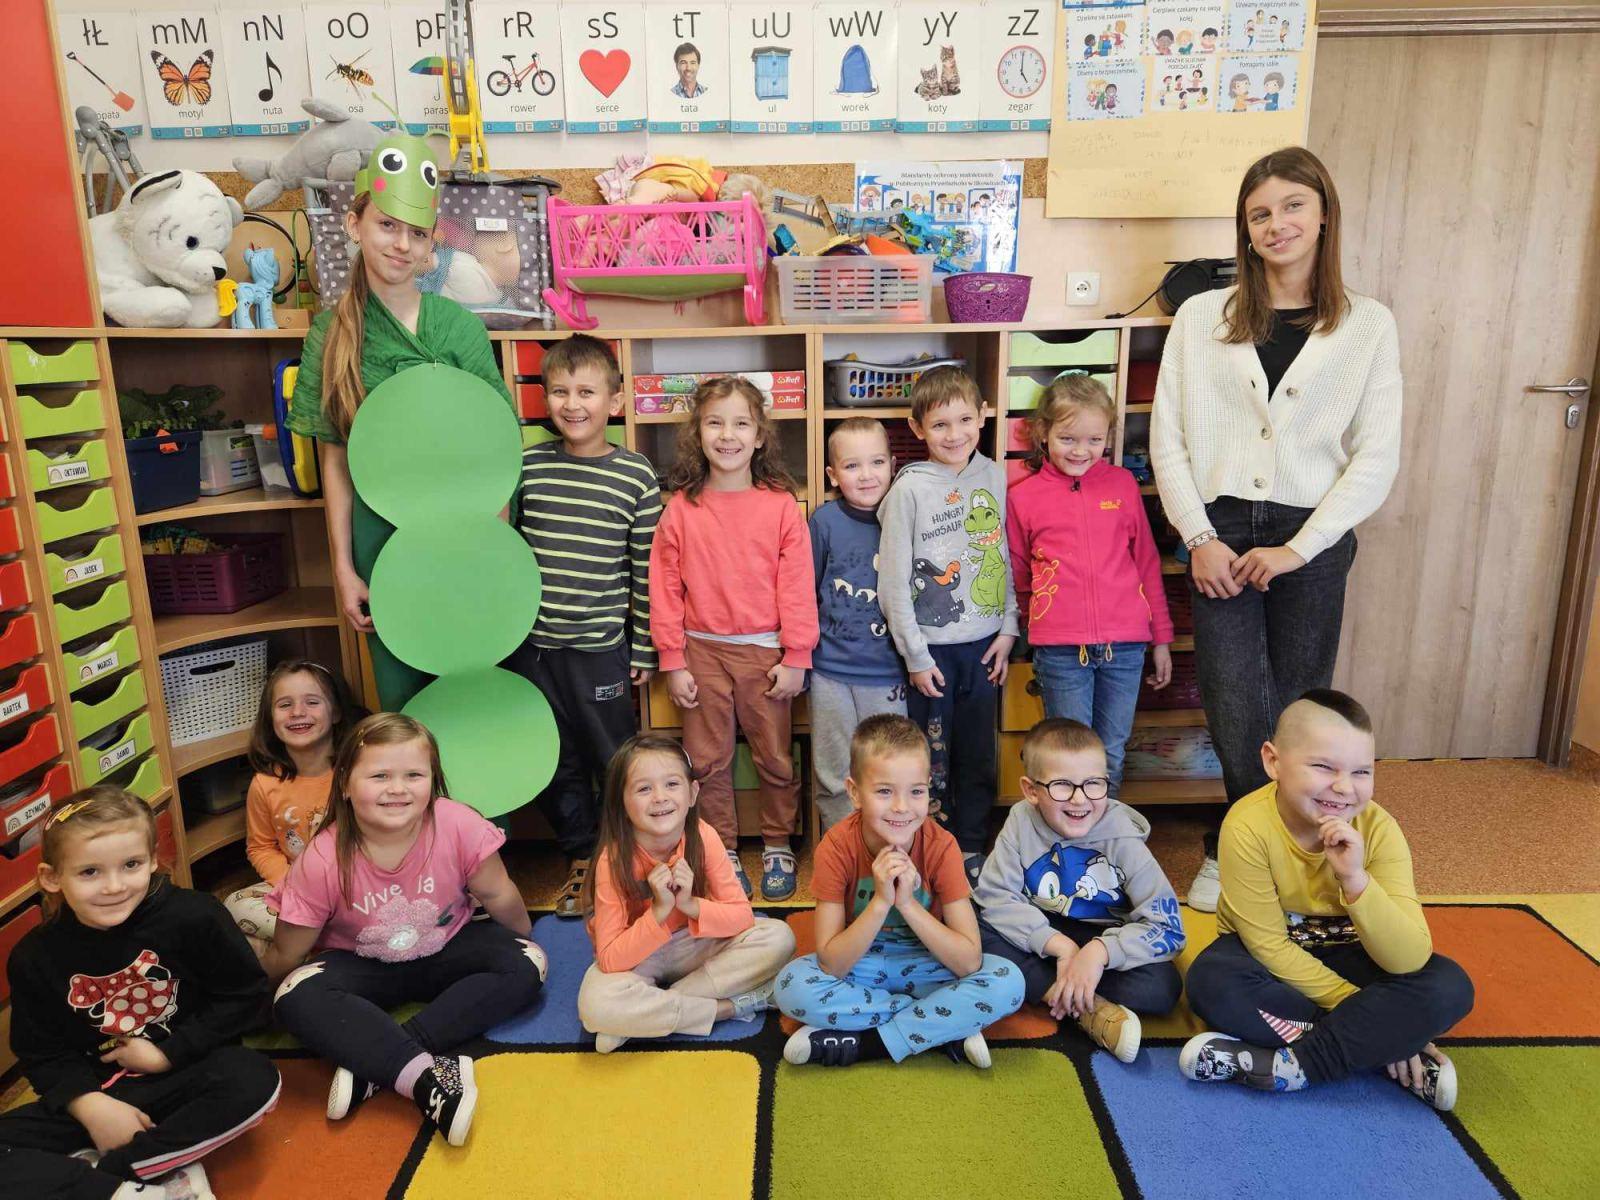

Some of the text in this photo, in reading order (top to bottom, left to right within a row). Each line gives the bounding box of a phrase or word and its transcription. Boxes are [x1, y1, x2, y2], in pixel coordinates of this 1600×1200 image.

[243, 14, 284, 41] nN
[327, 12, 369, 39] oO
[503, 11, 535, 38] rR
[587, 12, 619, 38] sS
[672, 11, 701, 38] tT
[752, 12, 791, 39] uU
[828, 10, 883, 38] wW
[922, 11, 958, 46] yY
[1007, 9, 1040, 36] zZ
[151, 17, 208, 45] mM
[178, 108, 205, 120] motyl
[262, 106, 283, 116] nuta
[348, 105, 364, 113] osa
[423, 107, 449, 116] paras
[510, 104, 537, 113] rower
[595, 104, 620, 113] serce
[680, 104, 699, 113] tata
[768, 104, 777, 113] ul
[841, 102, 870, 112] worek
[928, 103, 948, 115] koty
[1008, 102, 1033, 112] zegar
[96, 110, 120, 121] opata
[3, 700, 22, 717] BARTEK
[353, 874, 436, 916] Vive la
